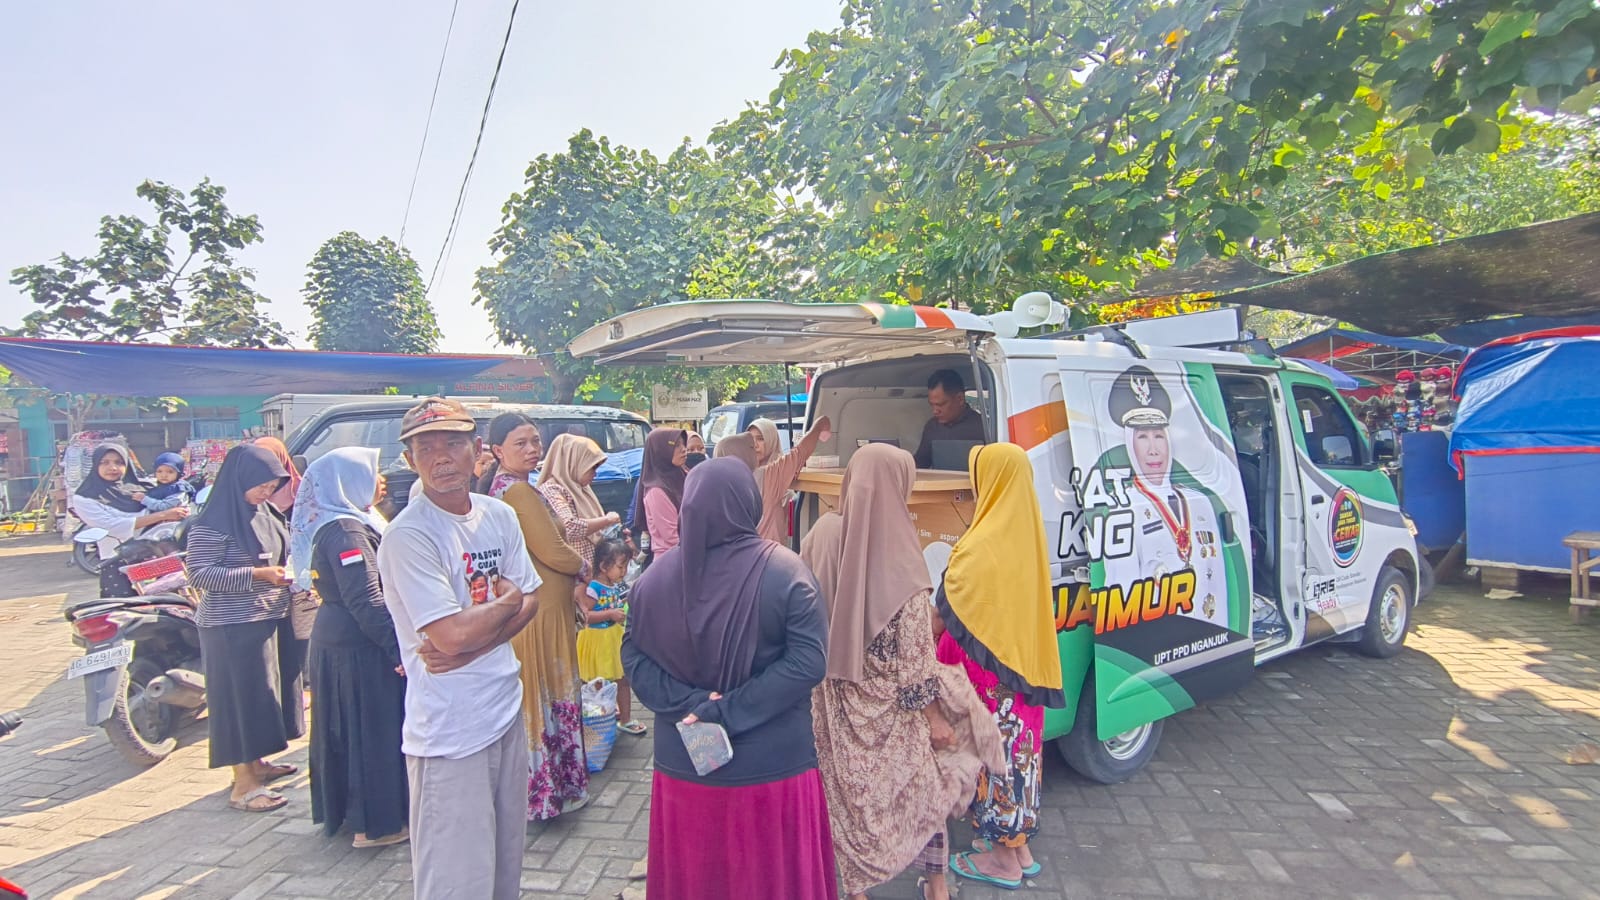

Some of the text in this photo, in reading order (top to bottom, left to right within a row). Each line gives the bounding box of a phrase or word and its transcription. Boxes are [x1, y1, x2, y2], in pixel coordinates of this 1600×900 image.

[497, 383, 534, 392] SILVER
[463, 552, 474, 575] 2
[1313, 579, 1335, 599] QRIS
[1090, 570, 1195, 635] IMUR
[1154, 632, 1228, 665] UPT PPD NGANJUK
